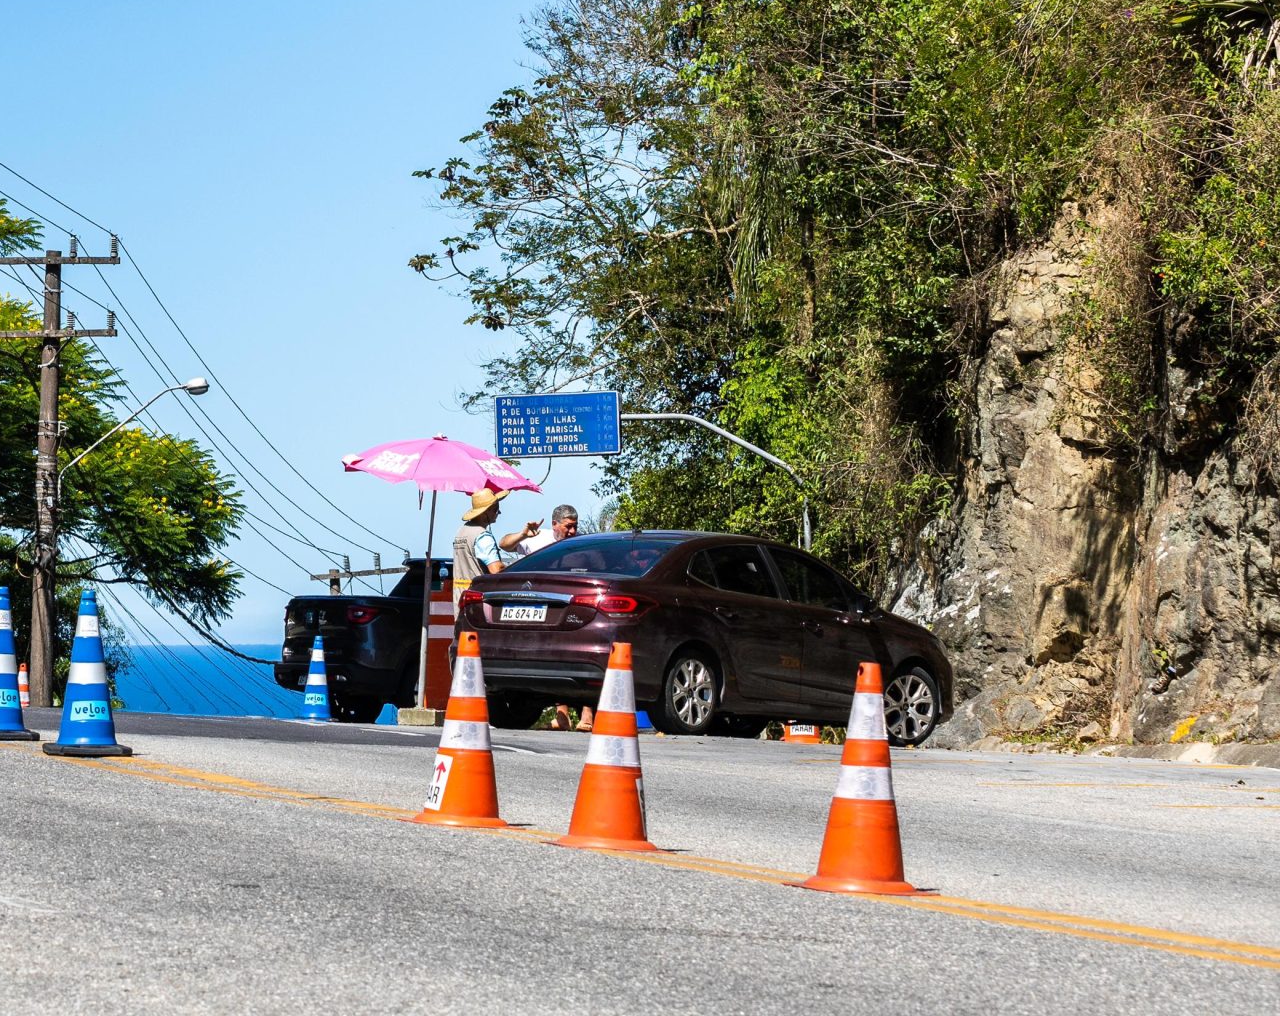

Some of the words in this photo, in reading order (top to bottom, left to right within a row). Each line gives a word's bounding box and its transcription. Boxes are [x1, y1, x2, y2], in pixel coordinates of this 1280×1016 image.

[511, 408, 521, 416] DE
[502, 417, 524, 426] PRAIA
[530, 416, 540, 425] DE
[553, 415, 577, 423] ILHAS
[502, 427, 525, 436] PRAIA
[545, 424, 583, 434] MARISCAL
[502, 437, 525, 445] PRAIA
[531, 436, 540, 444] DE
[545, 435, 579, 444] ZIMBROS
[512, 446, 522, 454] DO
[527, 445, 553, 454] CANTO
[558, 443, 589, 453] GRANDE
[503, 609, 513, 619] AC
[74, 703, 106, 718] veloe
